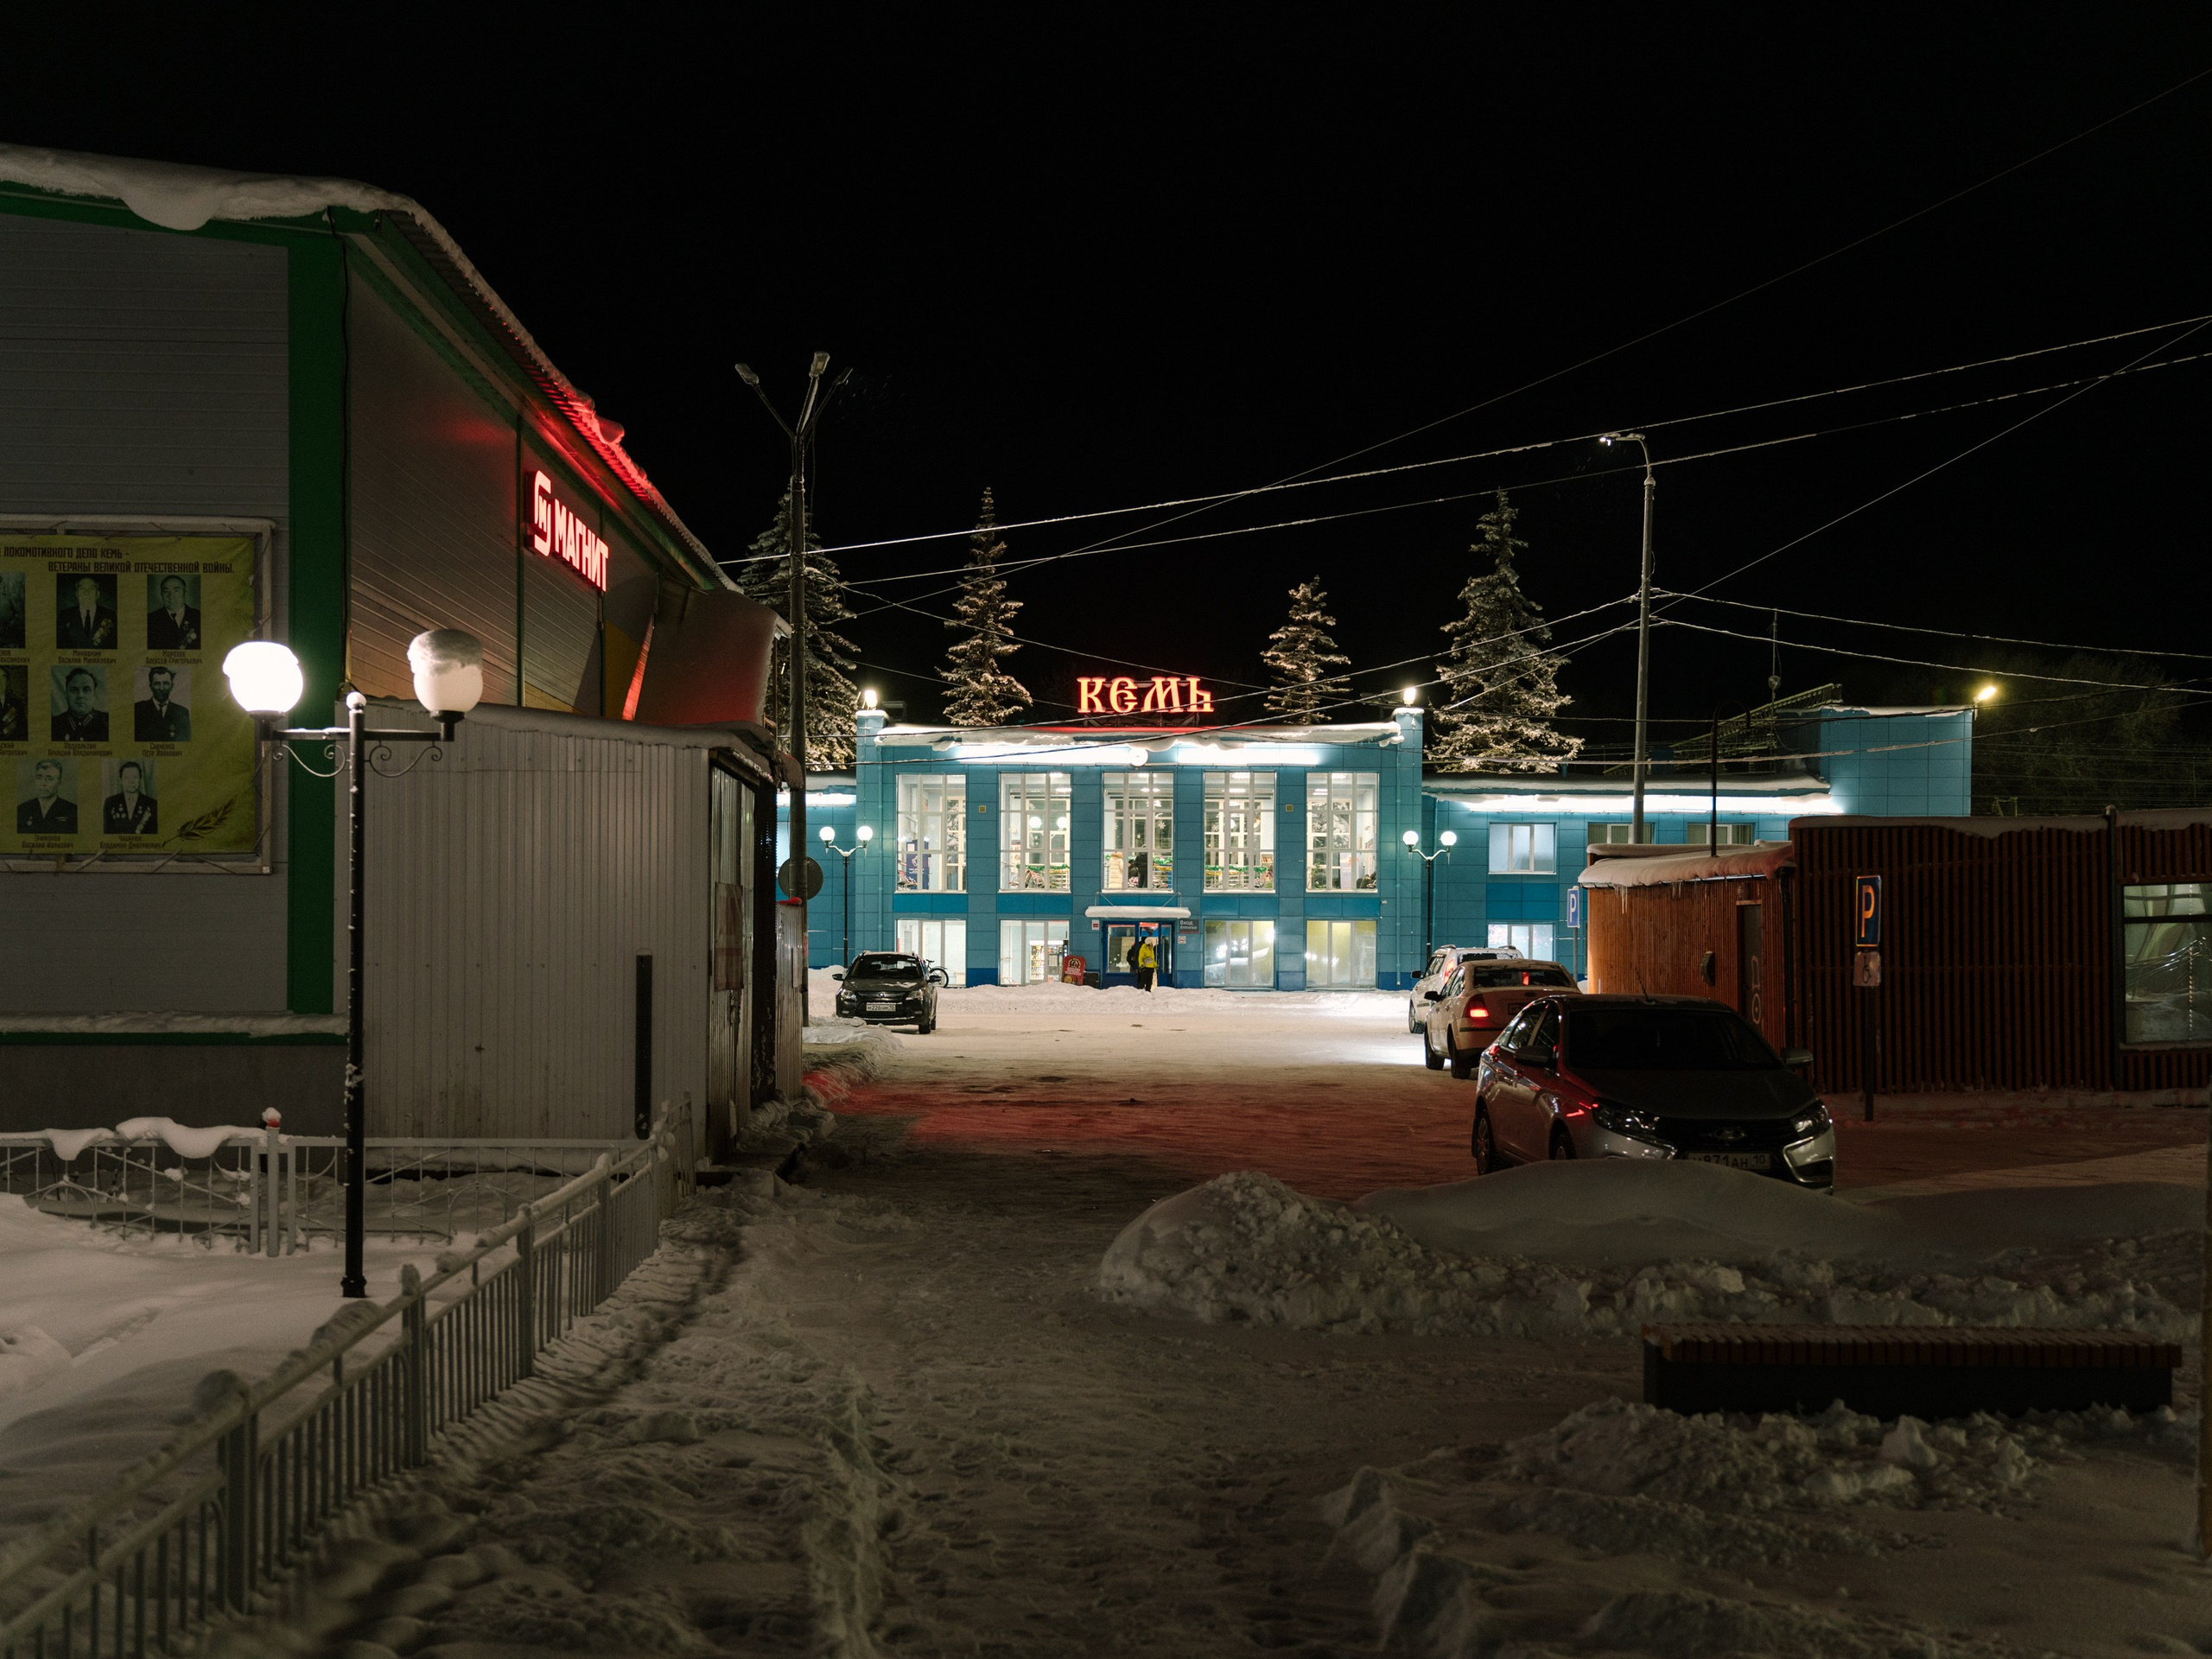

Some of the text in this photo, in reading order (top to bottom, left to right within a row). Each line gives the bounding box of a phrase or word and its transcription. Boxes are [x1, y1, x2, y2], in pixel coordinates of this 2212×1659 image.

[3, 546, 73, 558] ЛОКОМОТИВНОГО
[76, 548, 98, 559] ДЕПО
[100, 548, 123, 559] КЕМЬ
[555, 498, 609, 592] МАГНИТ
[48, 562, 91, 572] ВЕТЕРАНЫ
[93, 561, 131, 573] ВЕЛИКОЙ
[134, 561, 200, 573] ОТЕЧЕСТВЕННОЙ
[1077, 677, 1214, 714] КЕМЬ
[1570, 893, 1577, 923] P
[1861, 885, 1875, 938] P
[1693, 1154, 1766, 1168] 871АН 10
